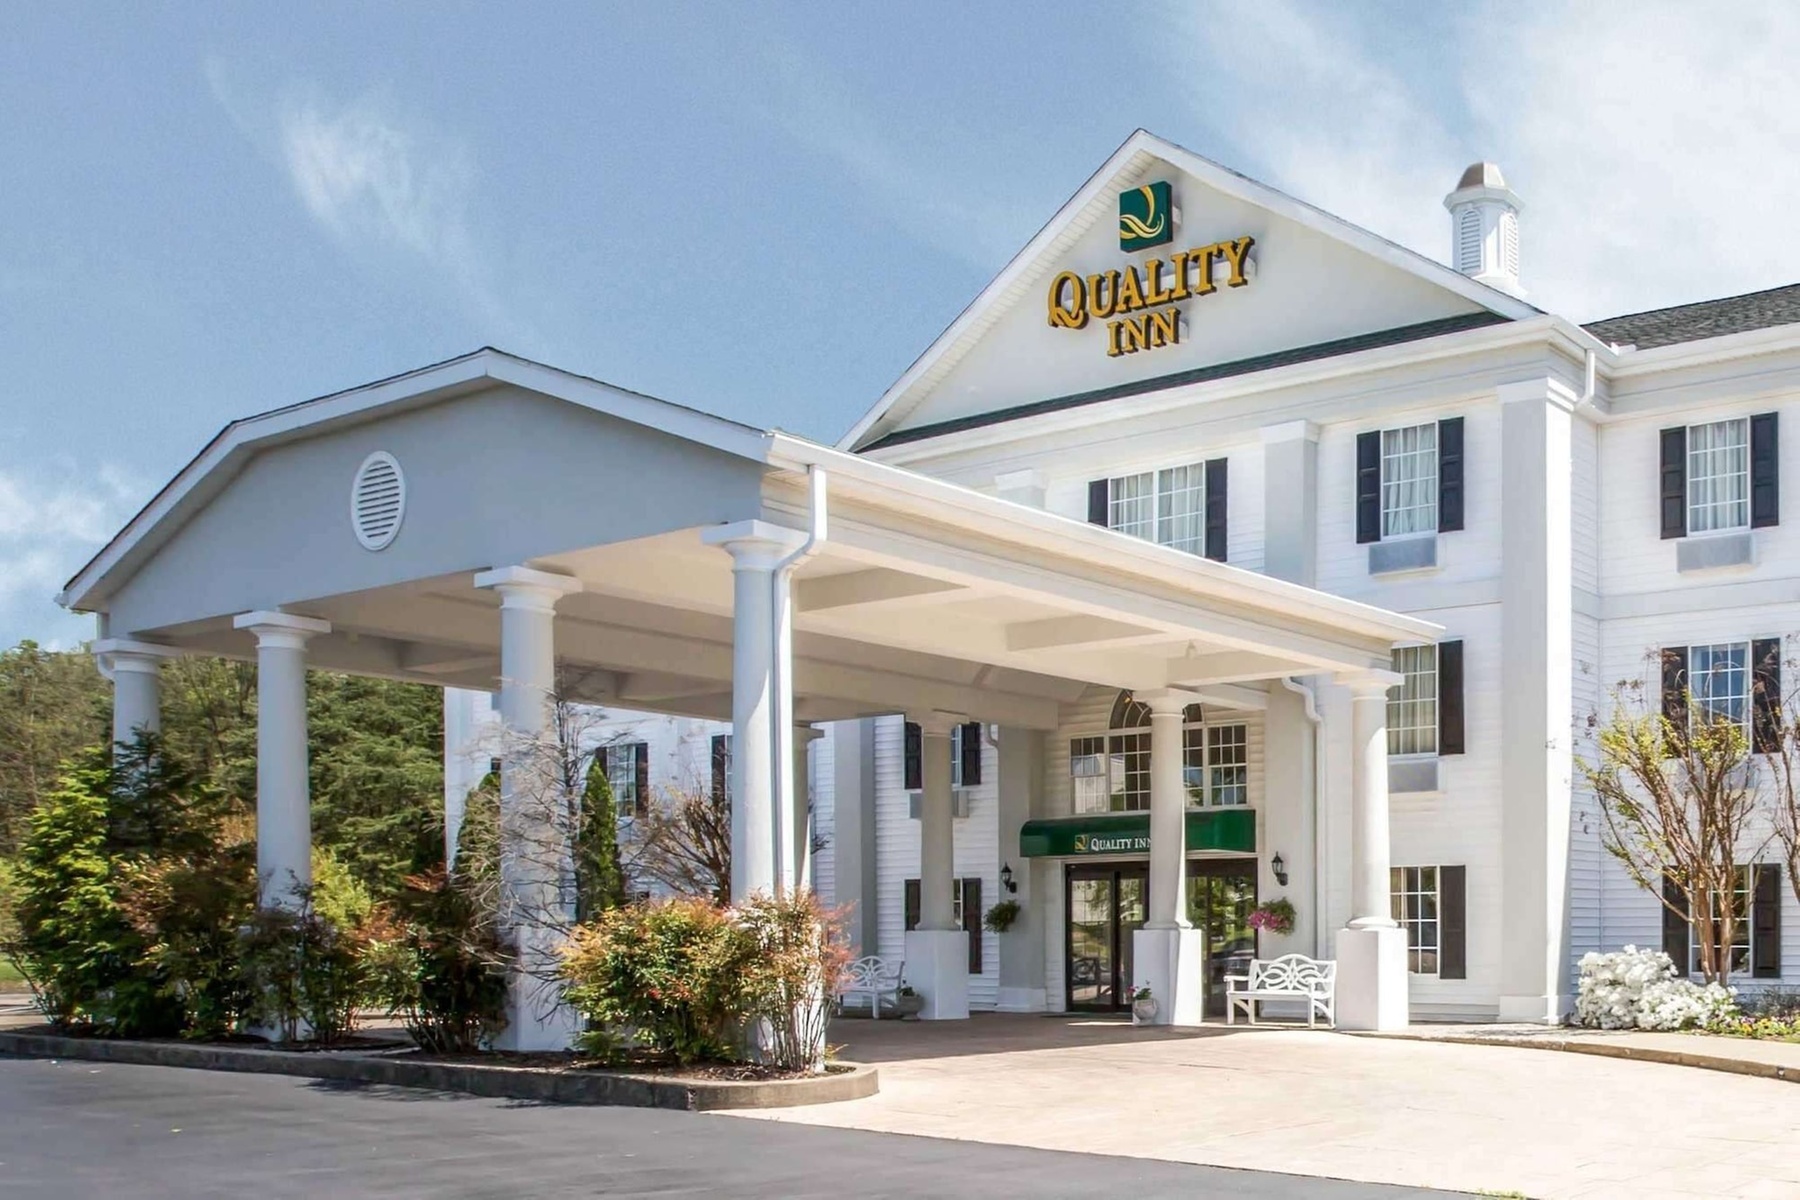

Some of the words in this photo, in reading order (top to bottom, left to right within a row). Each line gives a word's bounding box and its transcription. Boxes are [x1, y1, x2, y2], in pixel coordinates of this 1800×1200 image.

[1047, 236, 1255, 330] QUALITY
[1106, 307, 1181, 357] INN
[1091, 838, 1132, 851] QUALITY
